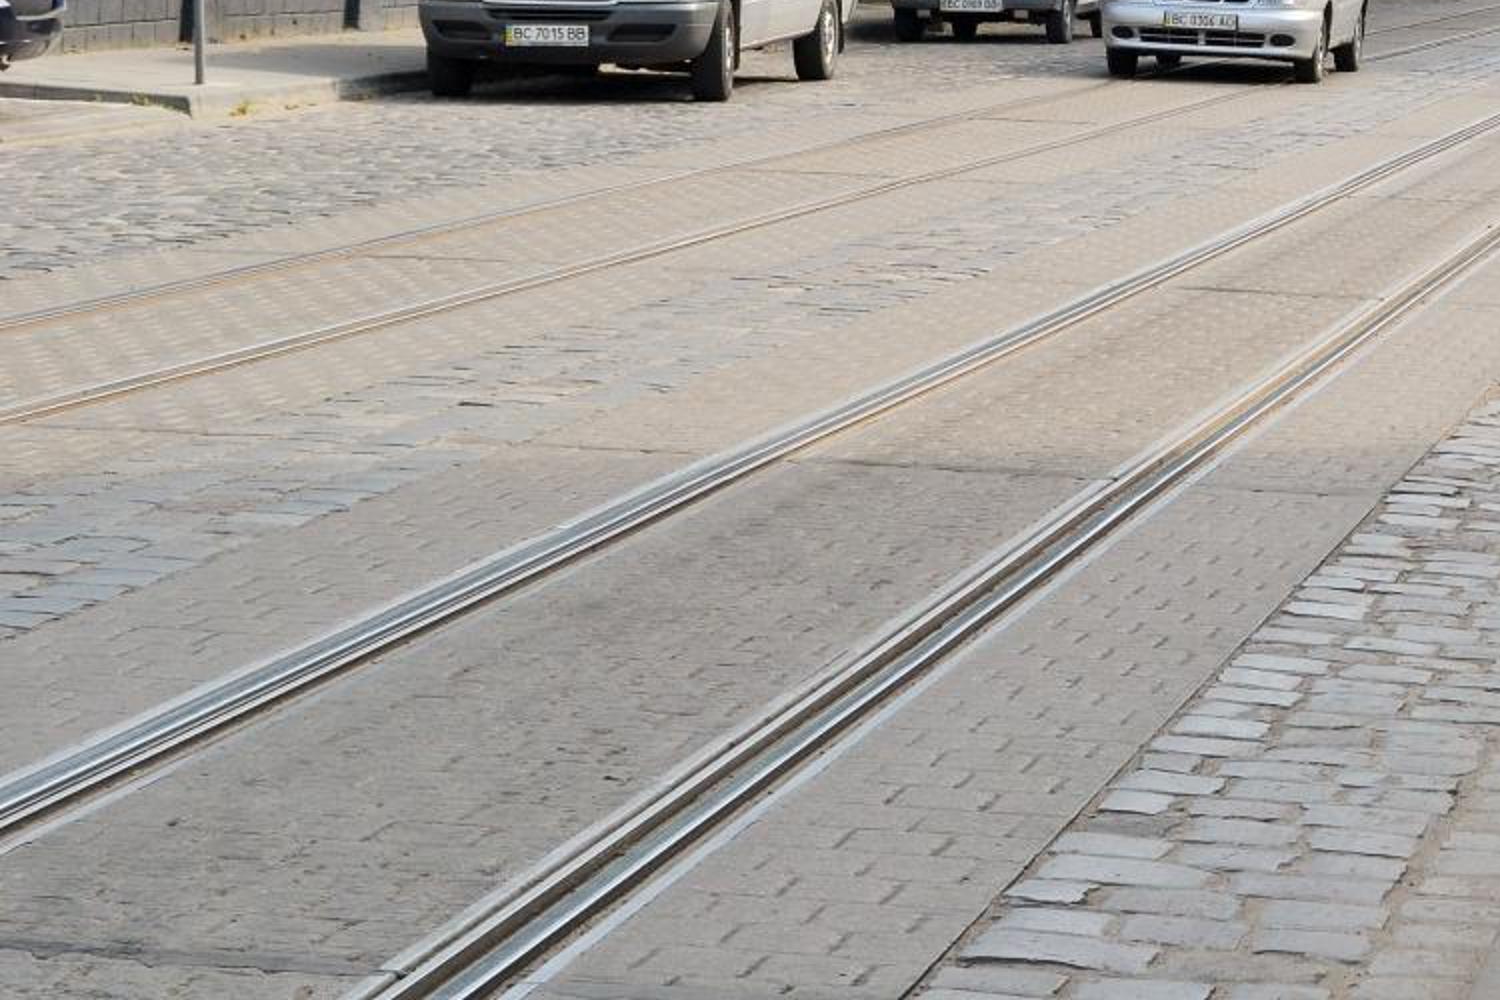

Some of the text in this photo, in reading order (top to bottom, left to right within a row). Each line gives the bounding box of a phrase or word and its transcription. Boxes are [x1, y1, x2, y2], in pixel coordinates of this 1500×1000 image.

[513, 26, 586, 41] BC 7015 BB
